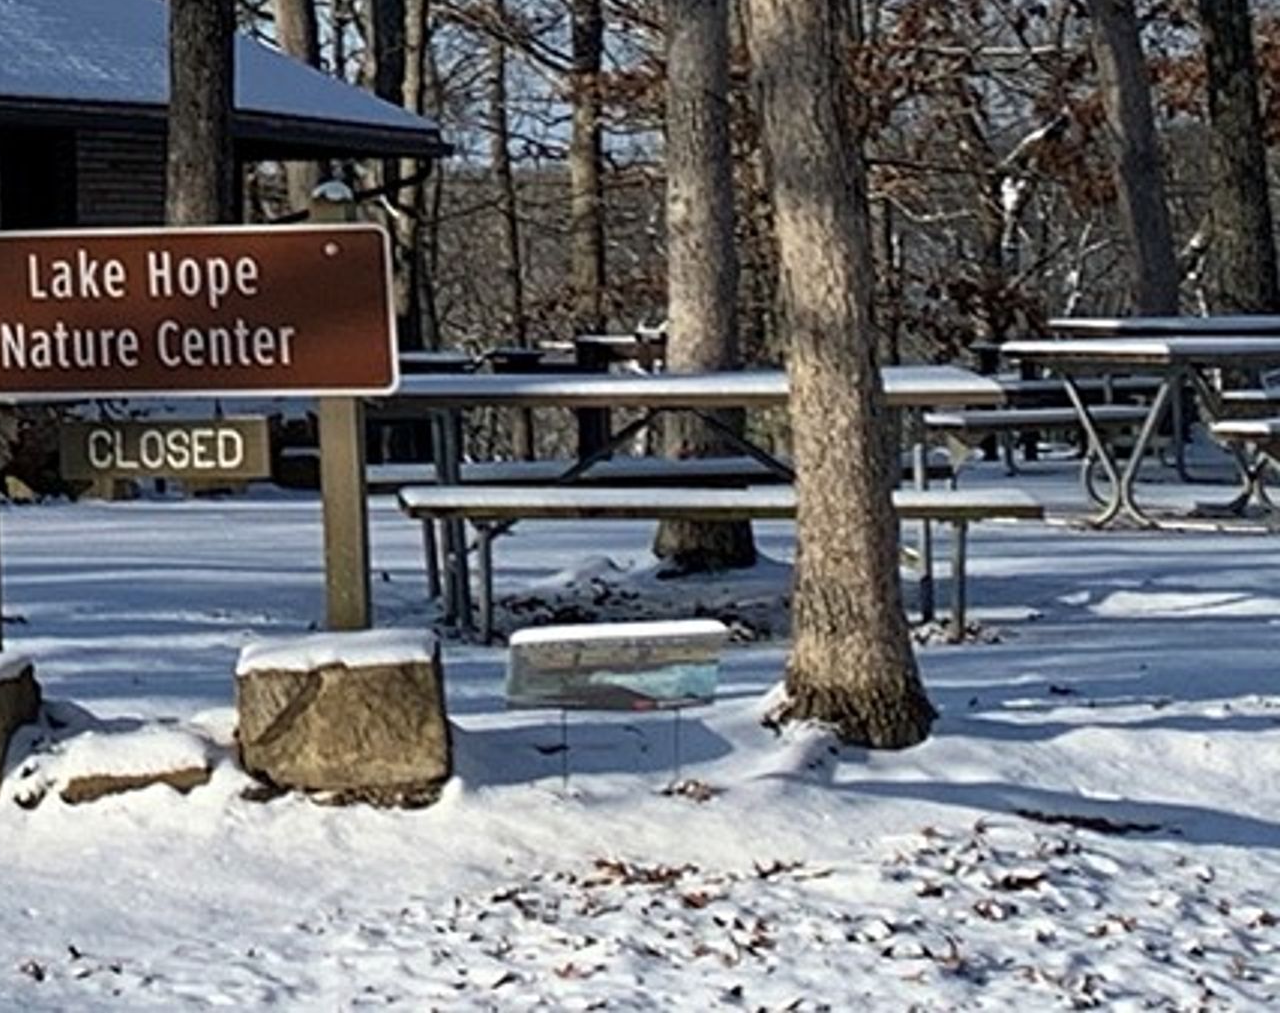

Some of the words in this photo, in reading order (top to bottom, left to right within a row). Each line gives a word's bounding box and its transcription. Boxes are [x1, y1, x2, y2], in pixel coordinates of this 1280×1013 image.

[27, 249, 127, 300] Lake
[147, 251, 259, 309] Hope
[0, 321, 139, 369] Nature
[157, 319, 296, 367] Center
[88, 428, 244, 470] CLOSED
